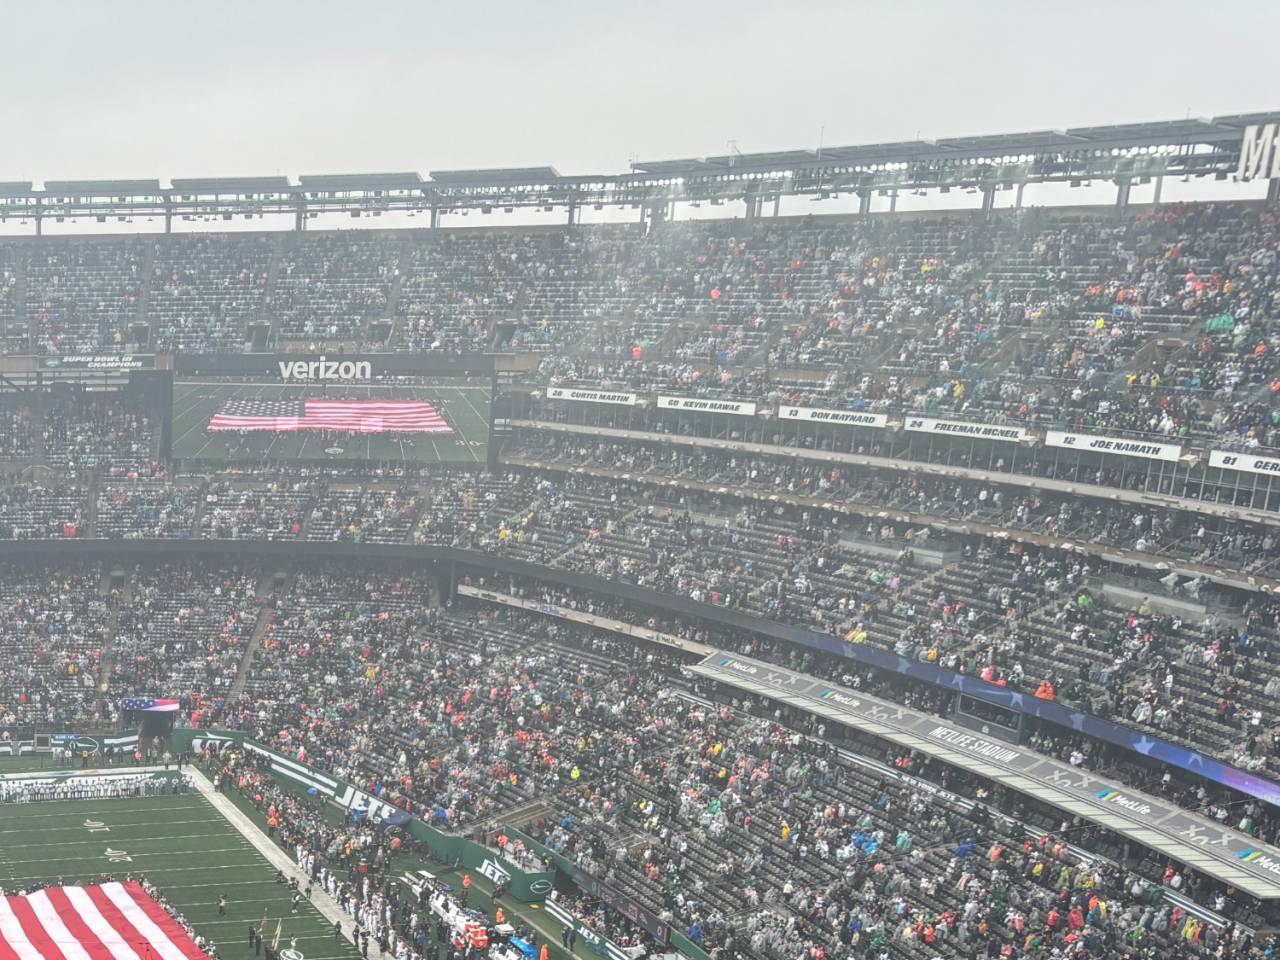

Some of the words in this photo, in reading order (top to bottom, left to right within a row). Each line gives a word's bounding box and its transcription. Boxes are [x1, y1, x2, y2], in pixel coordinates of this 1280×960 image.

[278, 356, 372, 379] verizon
[570, 391, 598, 400] CURTIS
[598, 393, 630, 402] MARTIN
[682, 400, 709, 409] KEVIN
[709, 402, 742, 412] MAWAE
[788, 409, 799, 417] 13
[810, 411, 830, 419] DON
[830, 413, 876, 425] MAYNARD
[909, 420, 923, 428] 24
[934, 423, 981, 435] FREEMAN
[982, 427, 1020, 439] MCNEIL
[1061, 436, 1077, 445] 12
[1089, 439, 1113, 450] JOE
[1114, 442, 1161, 456] NAMATH
[1222, 455, 1238, 466] 81
[1253, 460, 1280, 472] GER
[730, 661, 758, 674] MetLife
[830, 692, 862, 708] MetLife
[928, 726, 972, 748] METLIFE
[969, 737, 1020, 763] STADIUM
[1111, 794, 1152, 815] MetLife
[1254, 855, 1280, 875] Met
[577, 926, 602, 945] JETS
